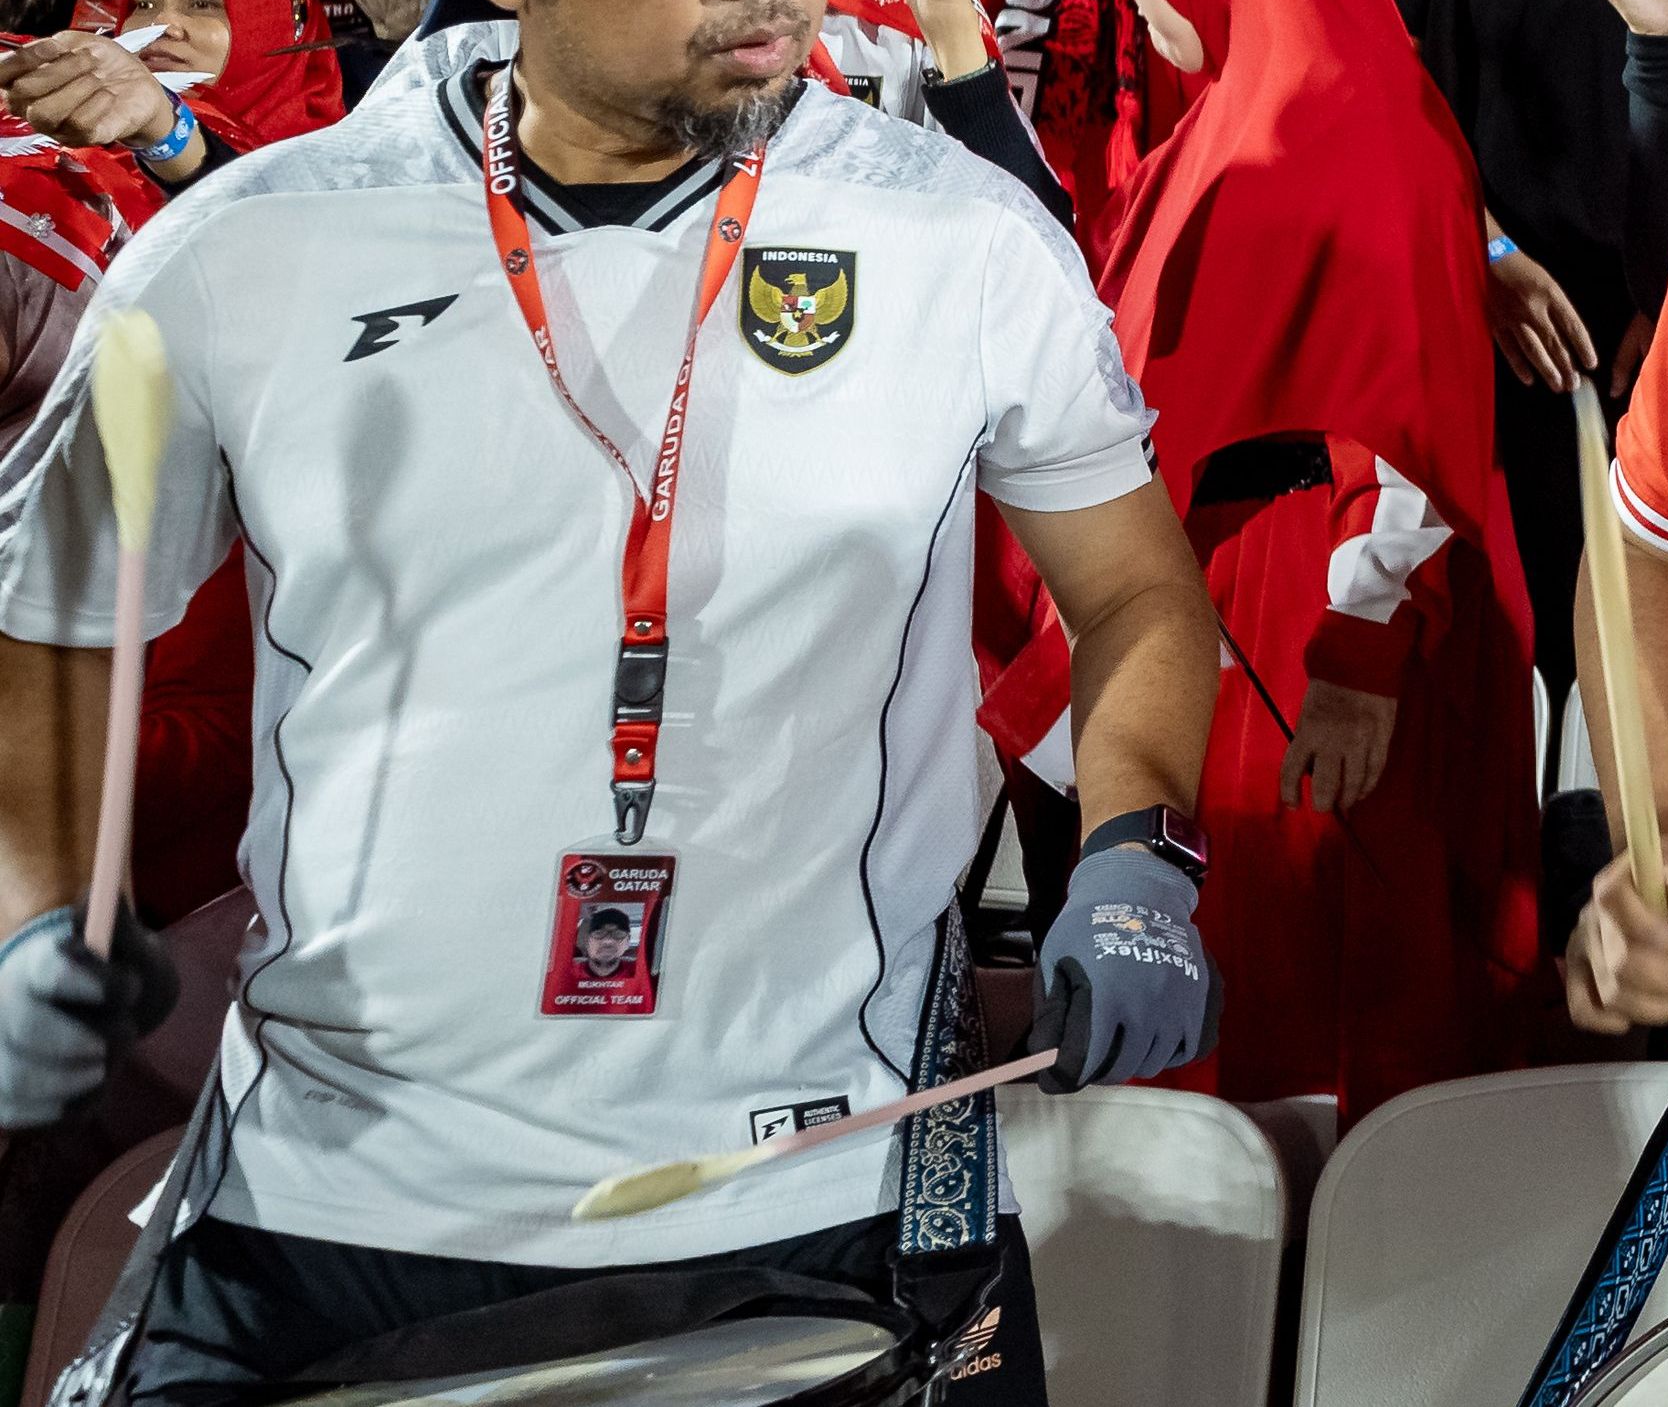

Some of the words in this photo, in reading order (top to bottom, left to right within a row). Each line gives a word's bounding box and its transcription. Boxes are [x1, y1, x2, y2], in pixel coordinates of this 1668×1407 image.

[487, 81, 517, 195] OFFICIAL
[762, 251, 838, 263] INDONESIA
[651, 392, 689, 523] GARUDA
[609, 868, 668, 880] GARUDA
[613, 880, 661, 892] QATAR
[1103, 945, 1199, 981] MaxiFlex
[554, 995, 608, 1005] OFFICIAL
[610, 995, 644, 1005] TEAM
[803, 1104, 841, 1117] AUTHENTIC
[950, 1353, 1002, 1381] didas
